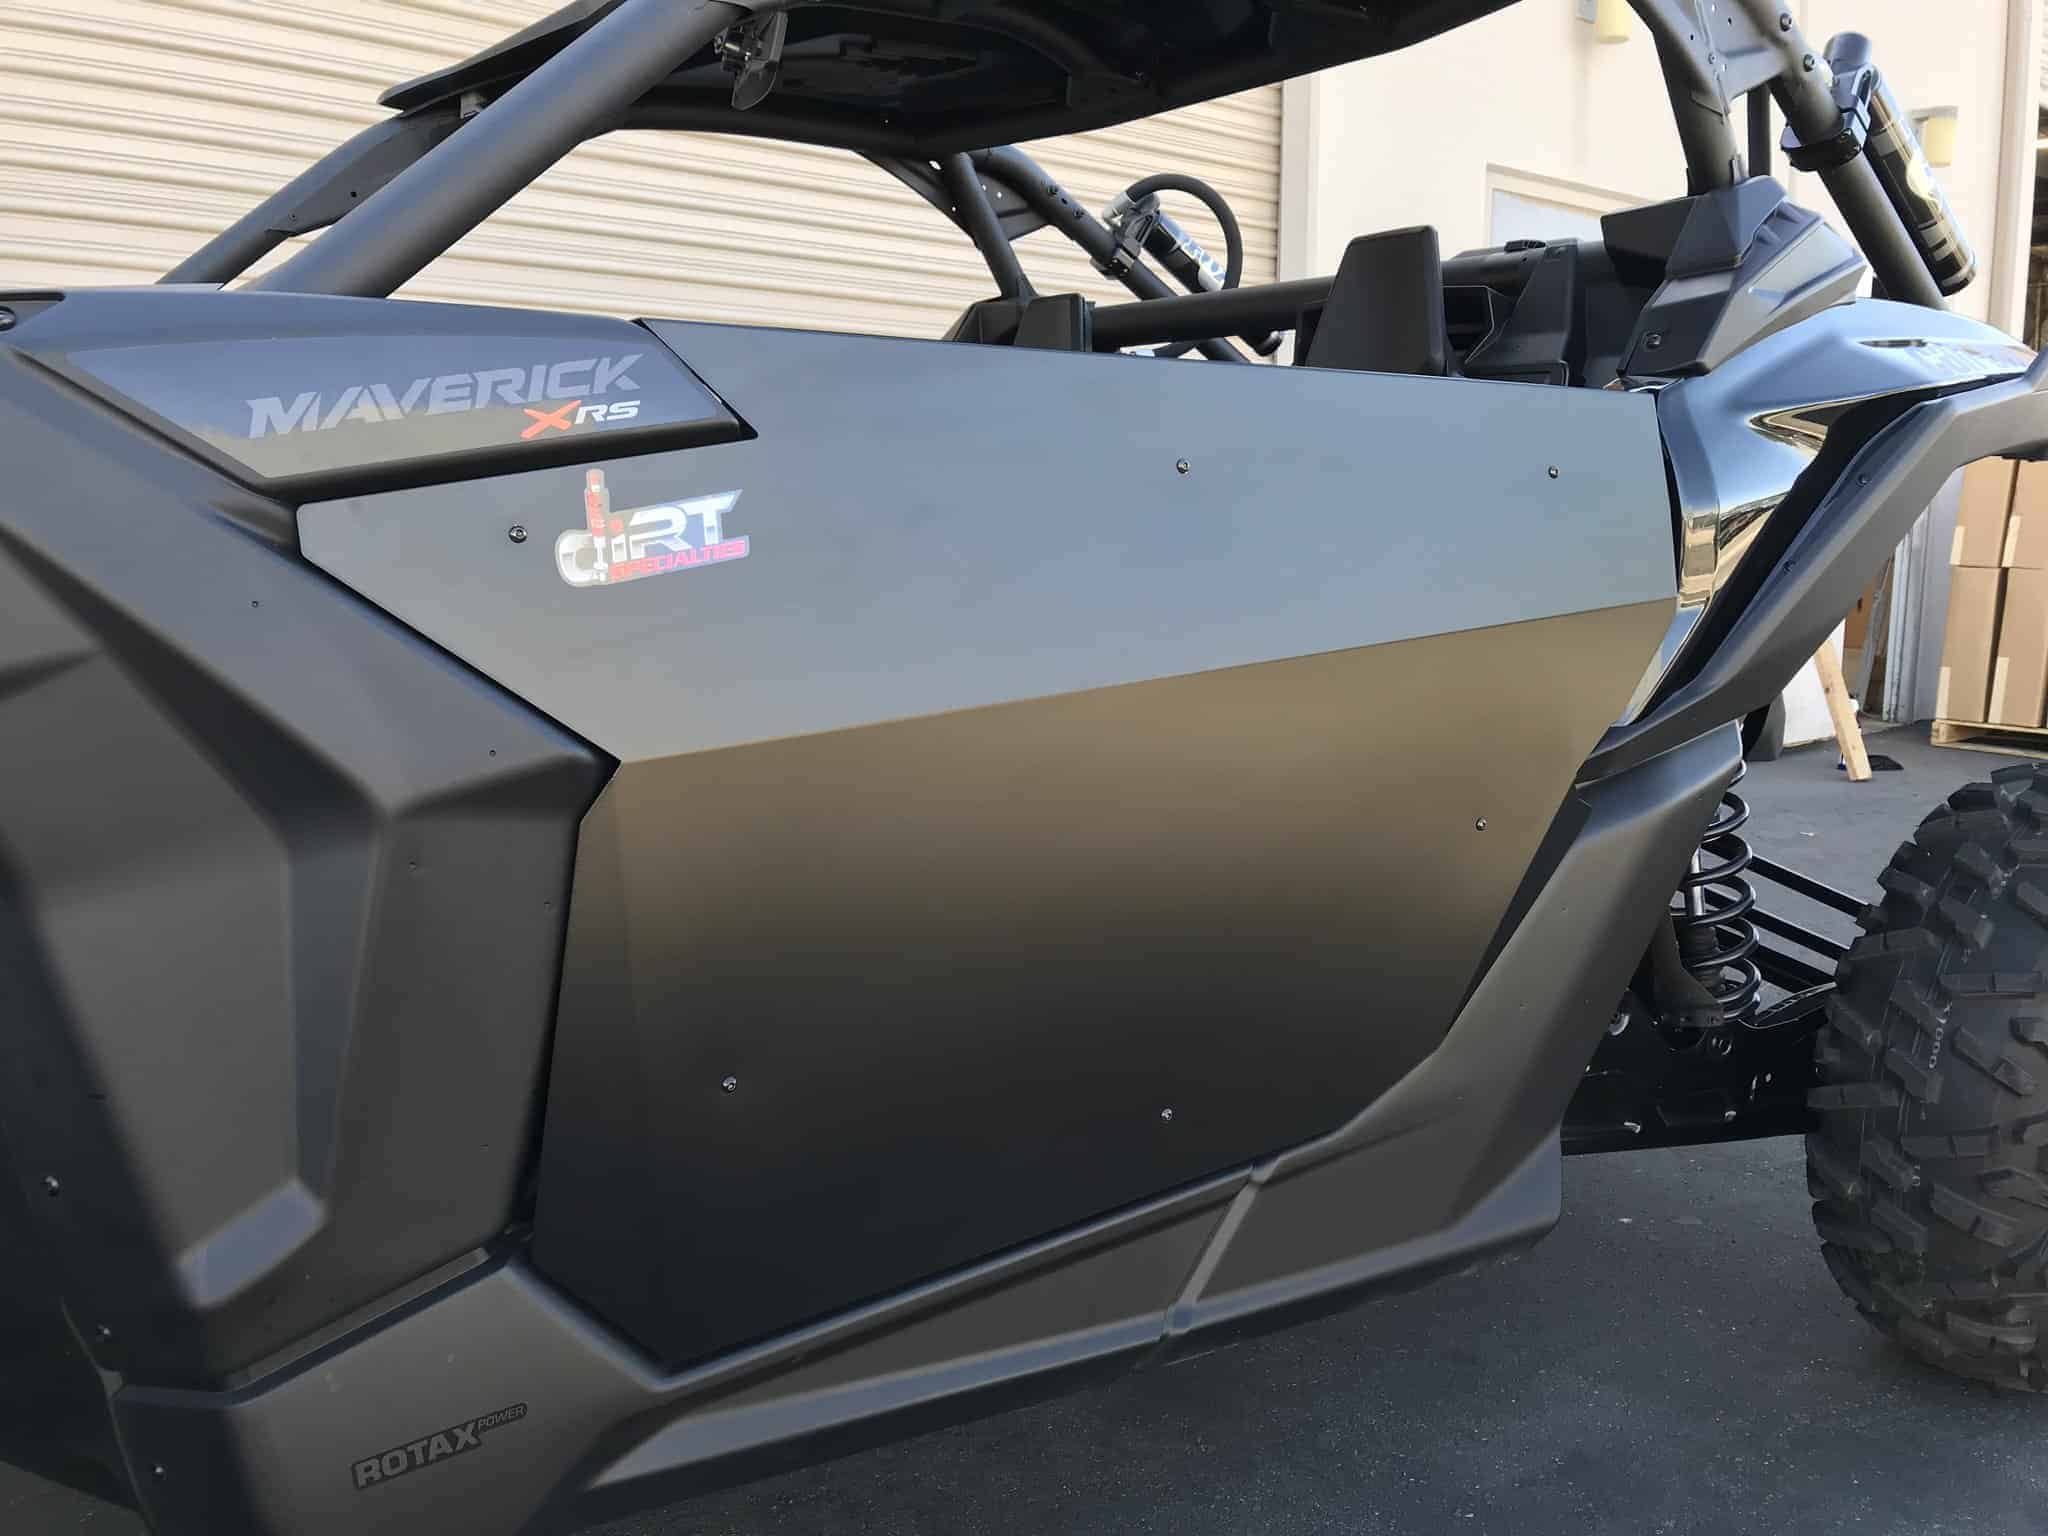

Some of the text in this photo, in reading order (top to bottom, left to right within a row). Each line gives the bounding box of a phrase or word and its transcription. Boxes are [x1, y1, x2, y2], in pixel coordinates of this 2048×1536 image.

[246, 353, 644, 438] MAVERICK
[356, 1405, 524, 1489] ROTAX POWER
